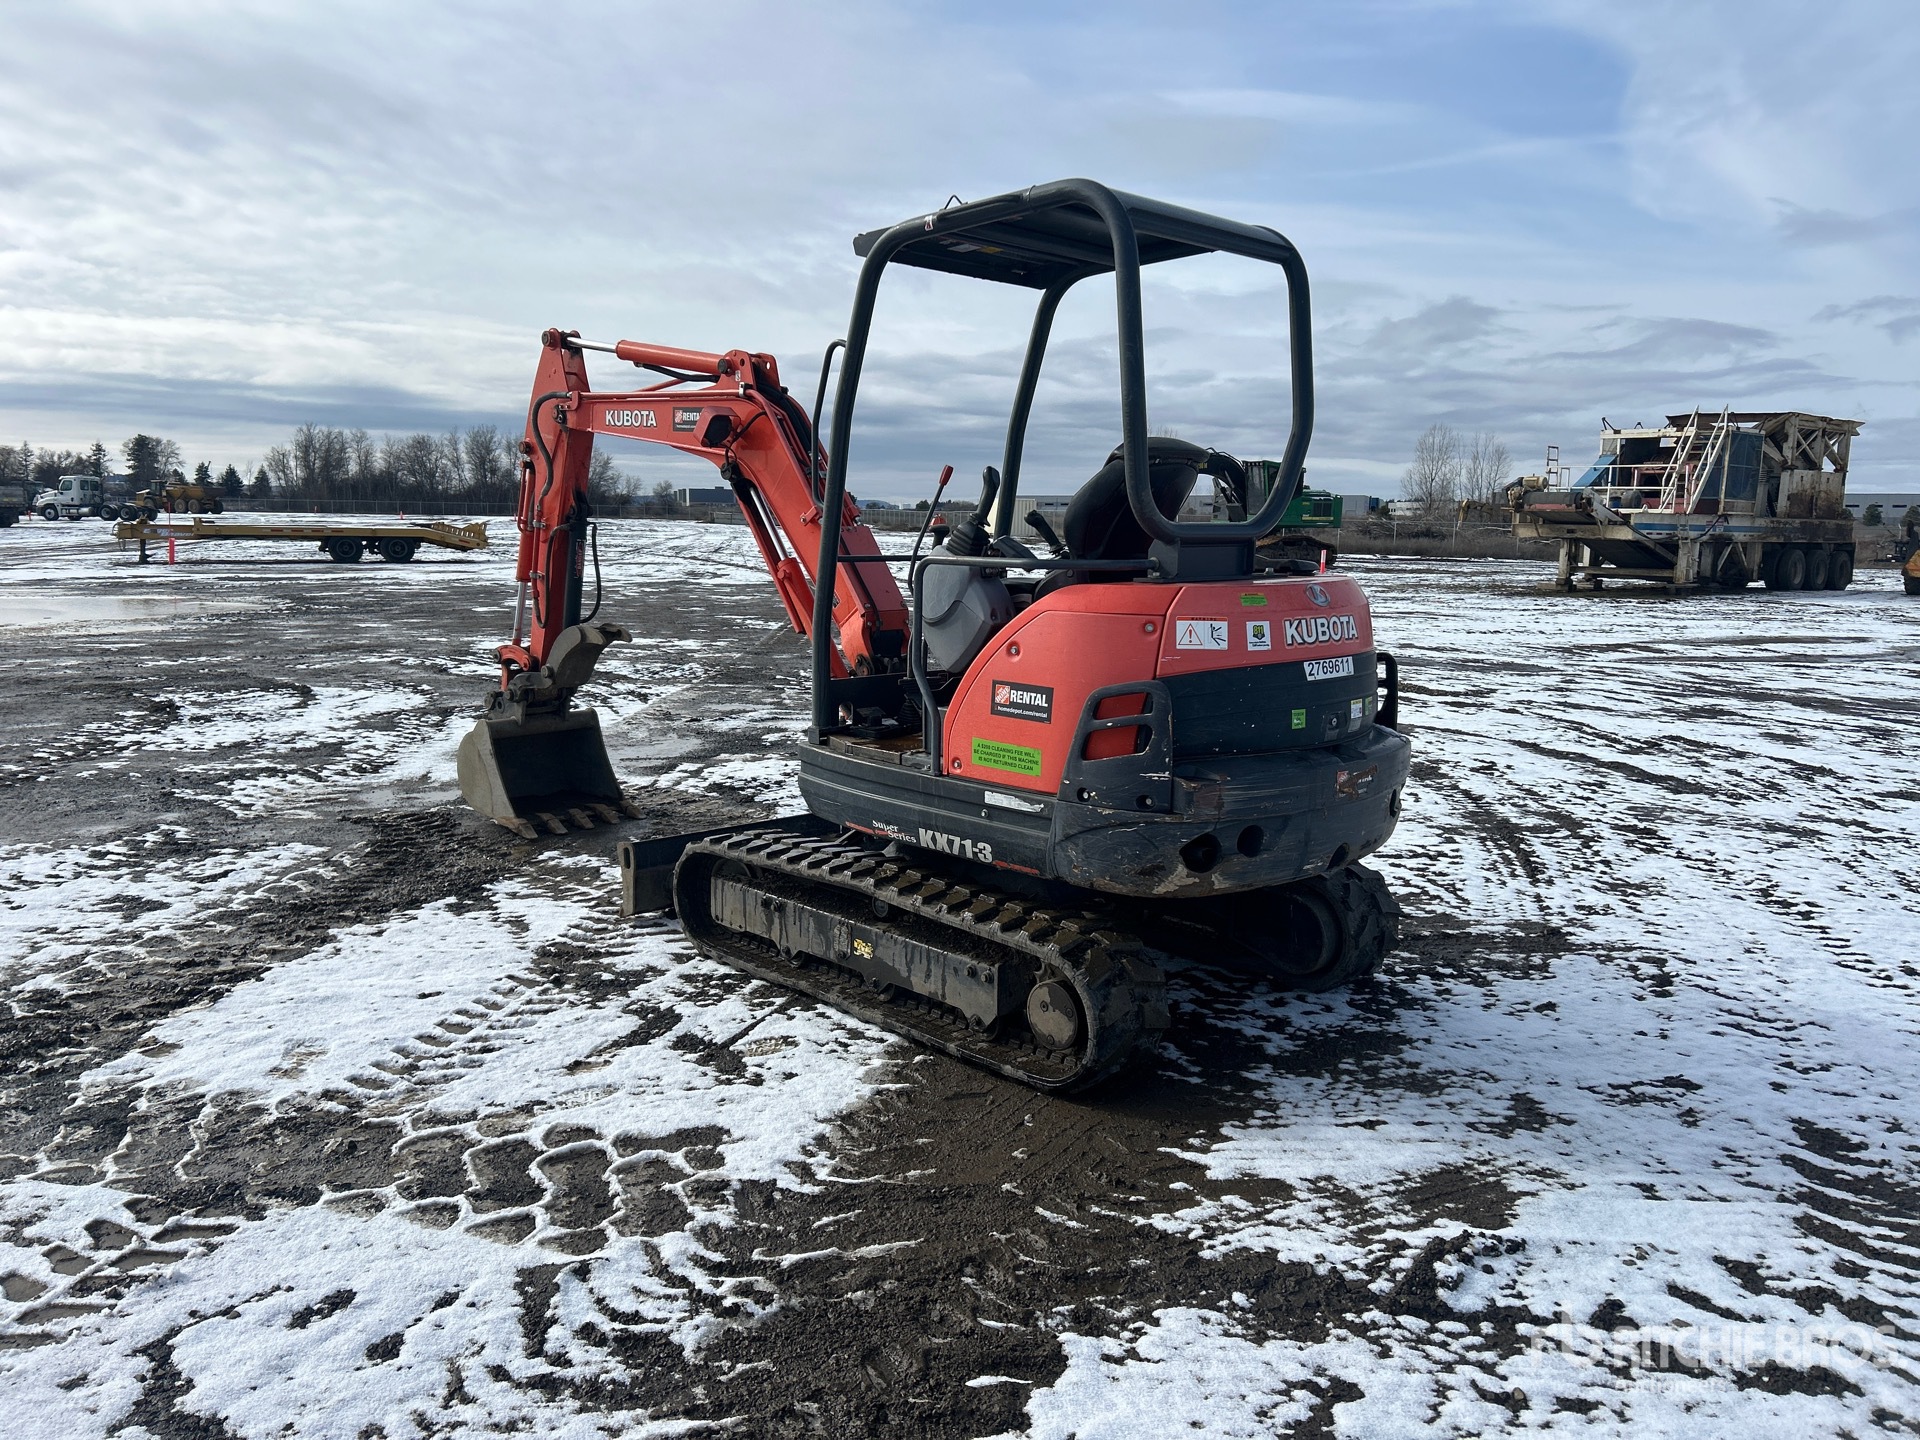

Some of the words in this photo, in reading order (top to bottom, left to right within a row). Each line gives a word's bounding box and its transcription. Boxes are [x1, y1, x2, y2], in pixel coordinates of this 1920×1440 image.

[605, 410, 657, 427] KUBOTA
[682, 412, 701, 421] RENTA
[1284, 615, 1358, 646] KUBOTA
[1308, 658, 1350, 676] 2769611
[1010, 690, 1048, 707] RENTAL
[997, 705, 1048, 718] homedepot.com/rental
[991, 746, 1014, 754] CLEANING
[980, 750, 1002, 758] CHARGED
[1018, 758, 1040, 766] MACHINE
[993, 759, 1017, 768] RETURNED
[872, 820, 899, 832] Super
[887, 830, 917, 843] Series
[918, 827, 993, 863] KX71-3
